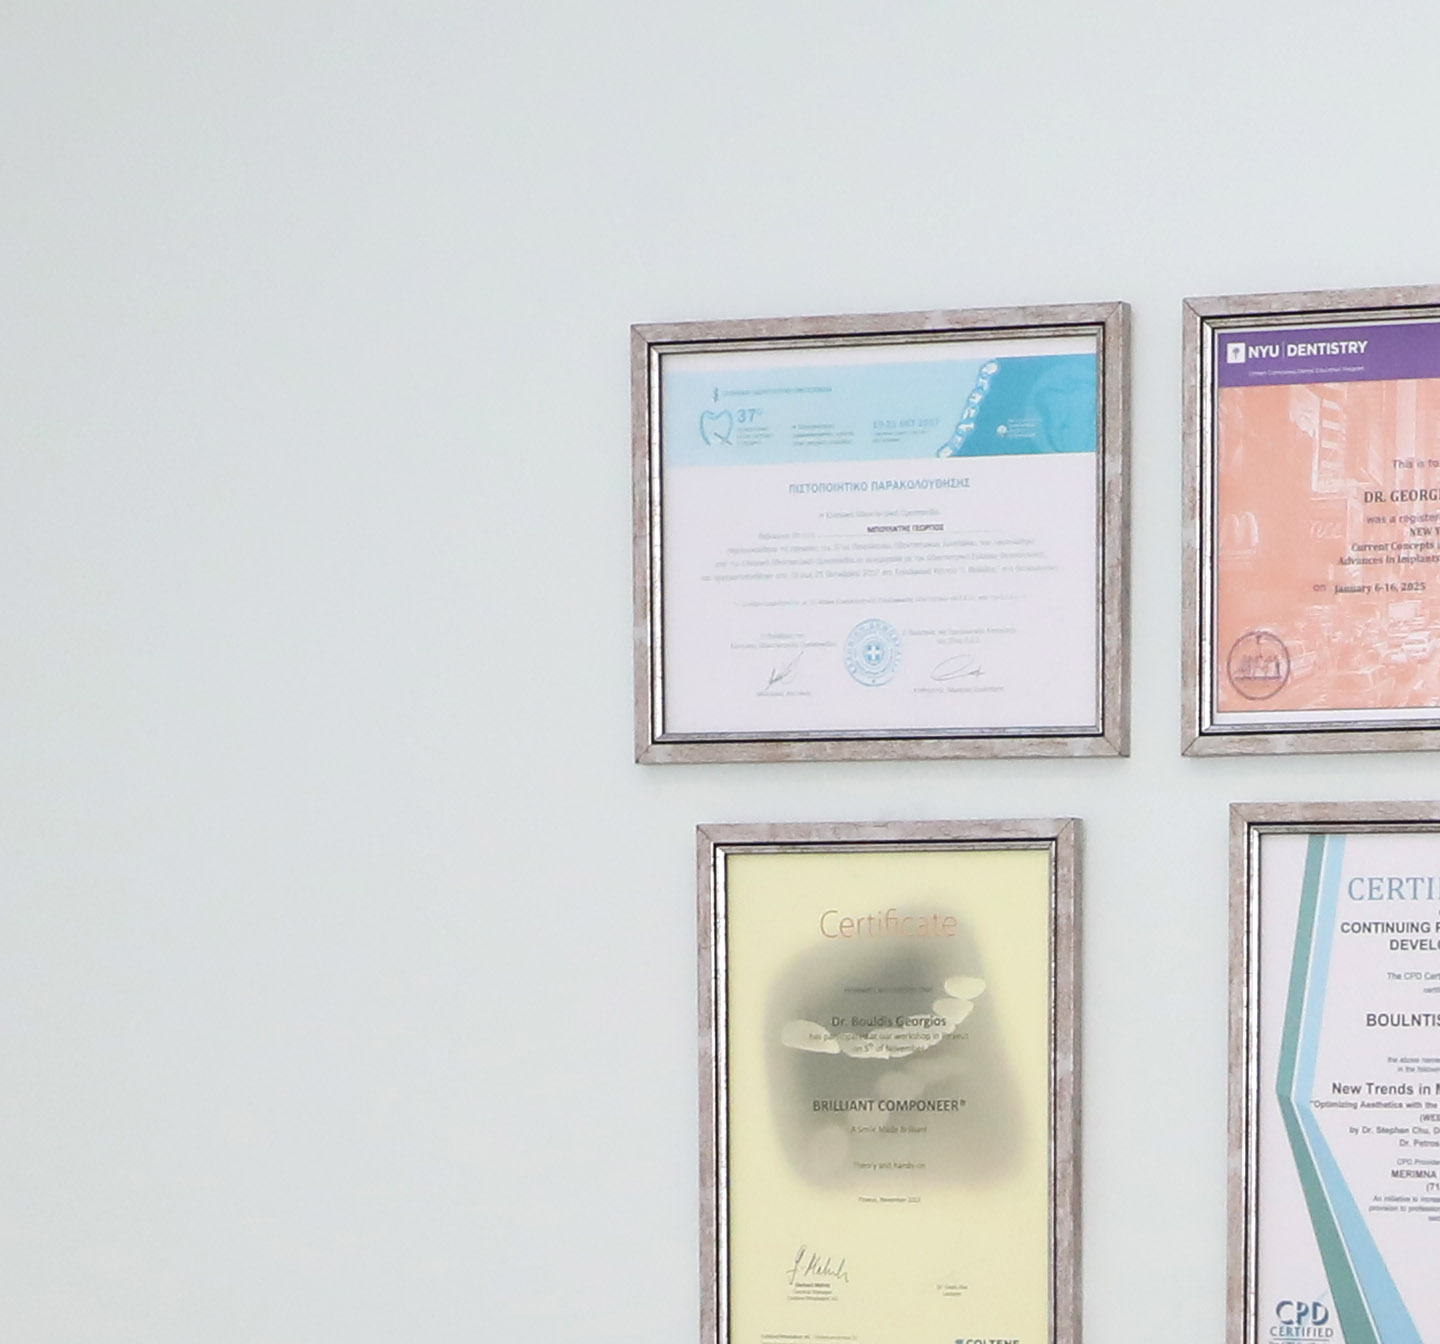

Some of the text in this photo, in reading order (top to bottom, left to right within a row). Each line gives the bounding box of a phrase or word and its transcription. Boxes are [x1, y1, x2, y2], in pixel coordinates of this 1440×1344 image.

[1248, 341, 1368, 358] NYU DENTISTRY
[1393, 459, 1413, 469] This
[1428, 459, 1439, 467] to
[1364, 491, 1386, 503] DR.
[1410, 527, 1432, 537] NEW
[1352, 542, 1389, 552] Current
[1391, 541, 1434, 552] Concepts
[1313, 583, 1326, 591] on
[1335, 583, 1372, 594] January
[1402, 582, 1426, 591] 2025
[820, 908, 957, 938] Certificate
[1340, 921, 1430, 934] CONTINUING
[896, 1016, 946, 1028] Georgios
[1332, 1083, 1361, 1094] New
[1367, 1083, 1413, 1095] Trends
[1419, 1083, 1431, 1095] in
[813, 1100, 873, 1111] BRILLIANT
[1392, 1170, 1436, 1179] MERIMNA
[1276, 1300, 1329, 1326] CPD
[1270, 1326, 1334, 1337] CERTIFIED
